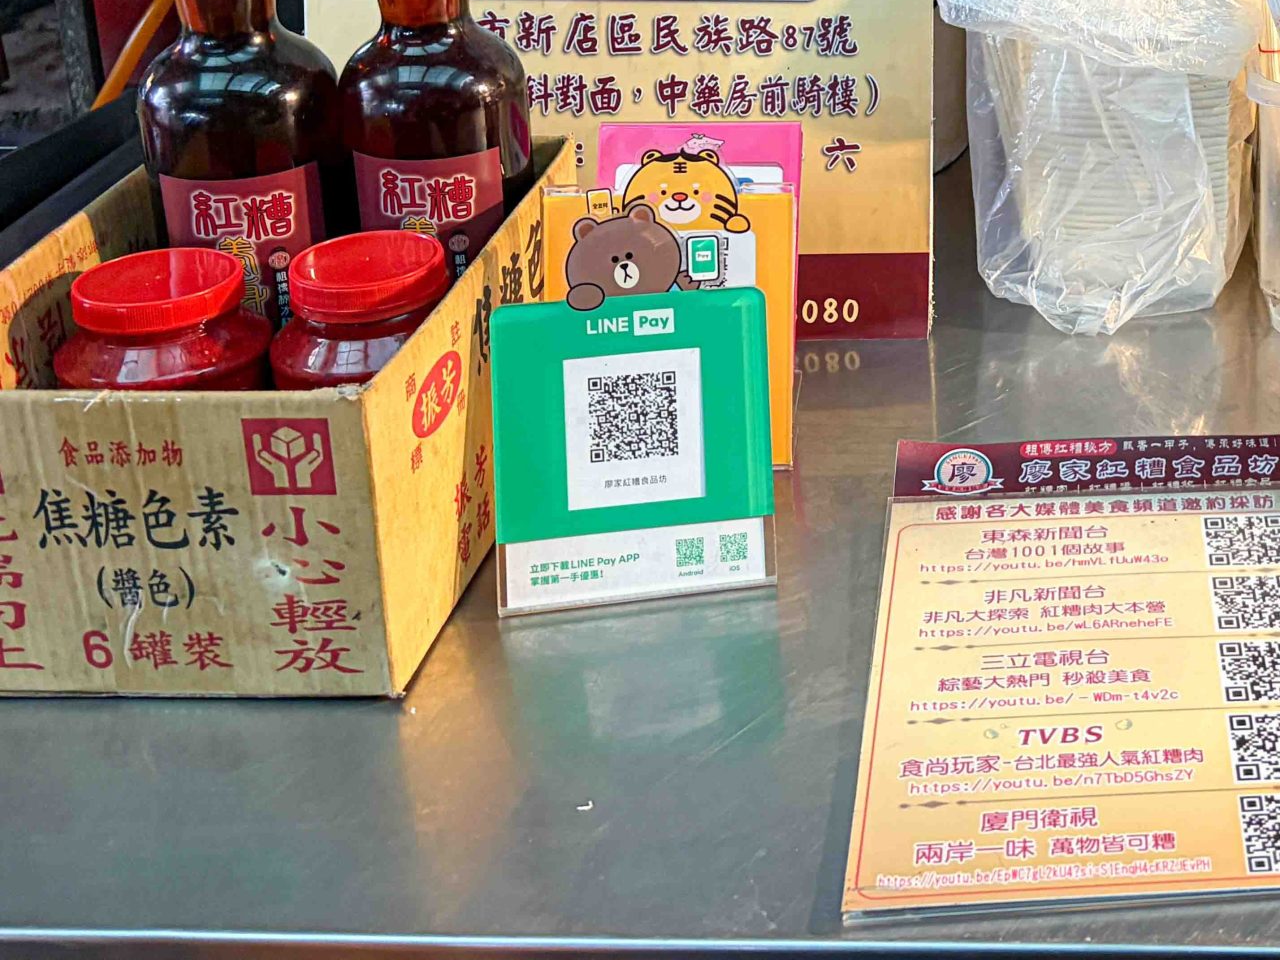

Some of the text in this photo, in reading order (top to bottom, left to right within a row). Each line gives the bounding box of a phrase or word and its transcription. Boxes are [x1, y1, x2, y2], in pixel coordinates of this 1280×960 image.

[824, 137, 861, 172] 六
[380, 170, 475, 222] 紅糟
[192, 191, 294, 241] 紅糟
[801, 297, 861, 325] 080
[586, 314, 670, 335] LINE Pay
[59, 436, 183, 468] 食品添加物
[948, 462, 977, 484] 廖
[1019, 454, 1280, 484] 廖家紅糟食品坊
[33, 486, 240, 551] 焦糖色素
[936, 495, 1275, 521] 感謝各大媒體美食頻道邀約採訪
[981, 525, 1109, 543] 東森新聞台
[597, 557, 616, 569] Pay
[618, 553, 640, 565] APP
[964, 542, 1126, 560] 台灣1001個故事
[678, 569, 704, 577] Android
[261, 506, 364, 674] 小心輕放
[984, 584, 1106, 604] 非凡新聞台
[924, 601, 1167, 624] 非凡大探索 紅糟肉大本營
[980, 649, 1110, 672] 三立電視台
[938, 669, 1152, 693] 綜藝大熱門 秒殺美食
[1018, 725, 1104, 746] TVBS
[980, 807, 1098, 833] 廈門衛視
[915, 832, 1176, 865] 兩岸一味 萬物皆可糟
